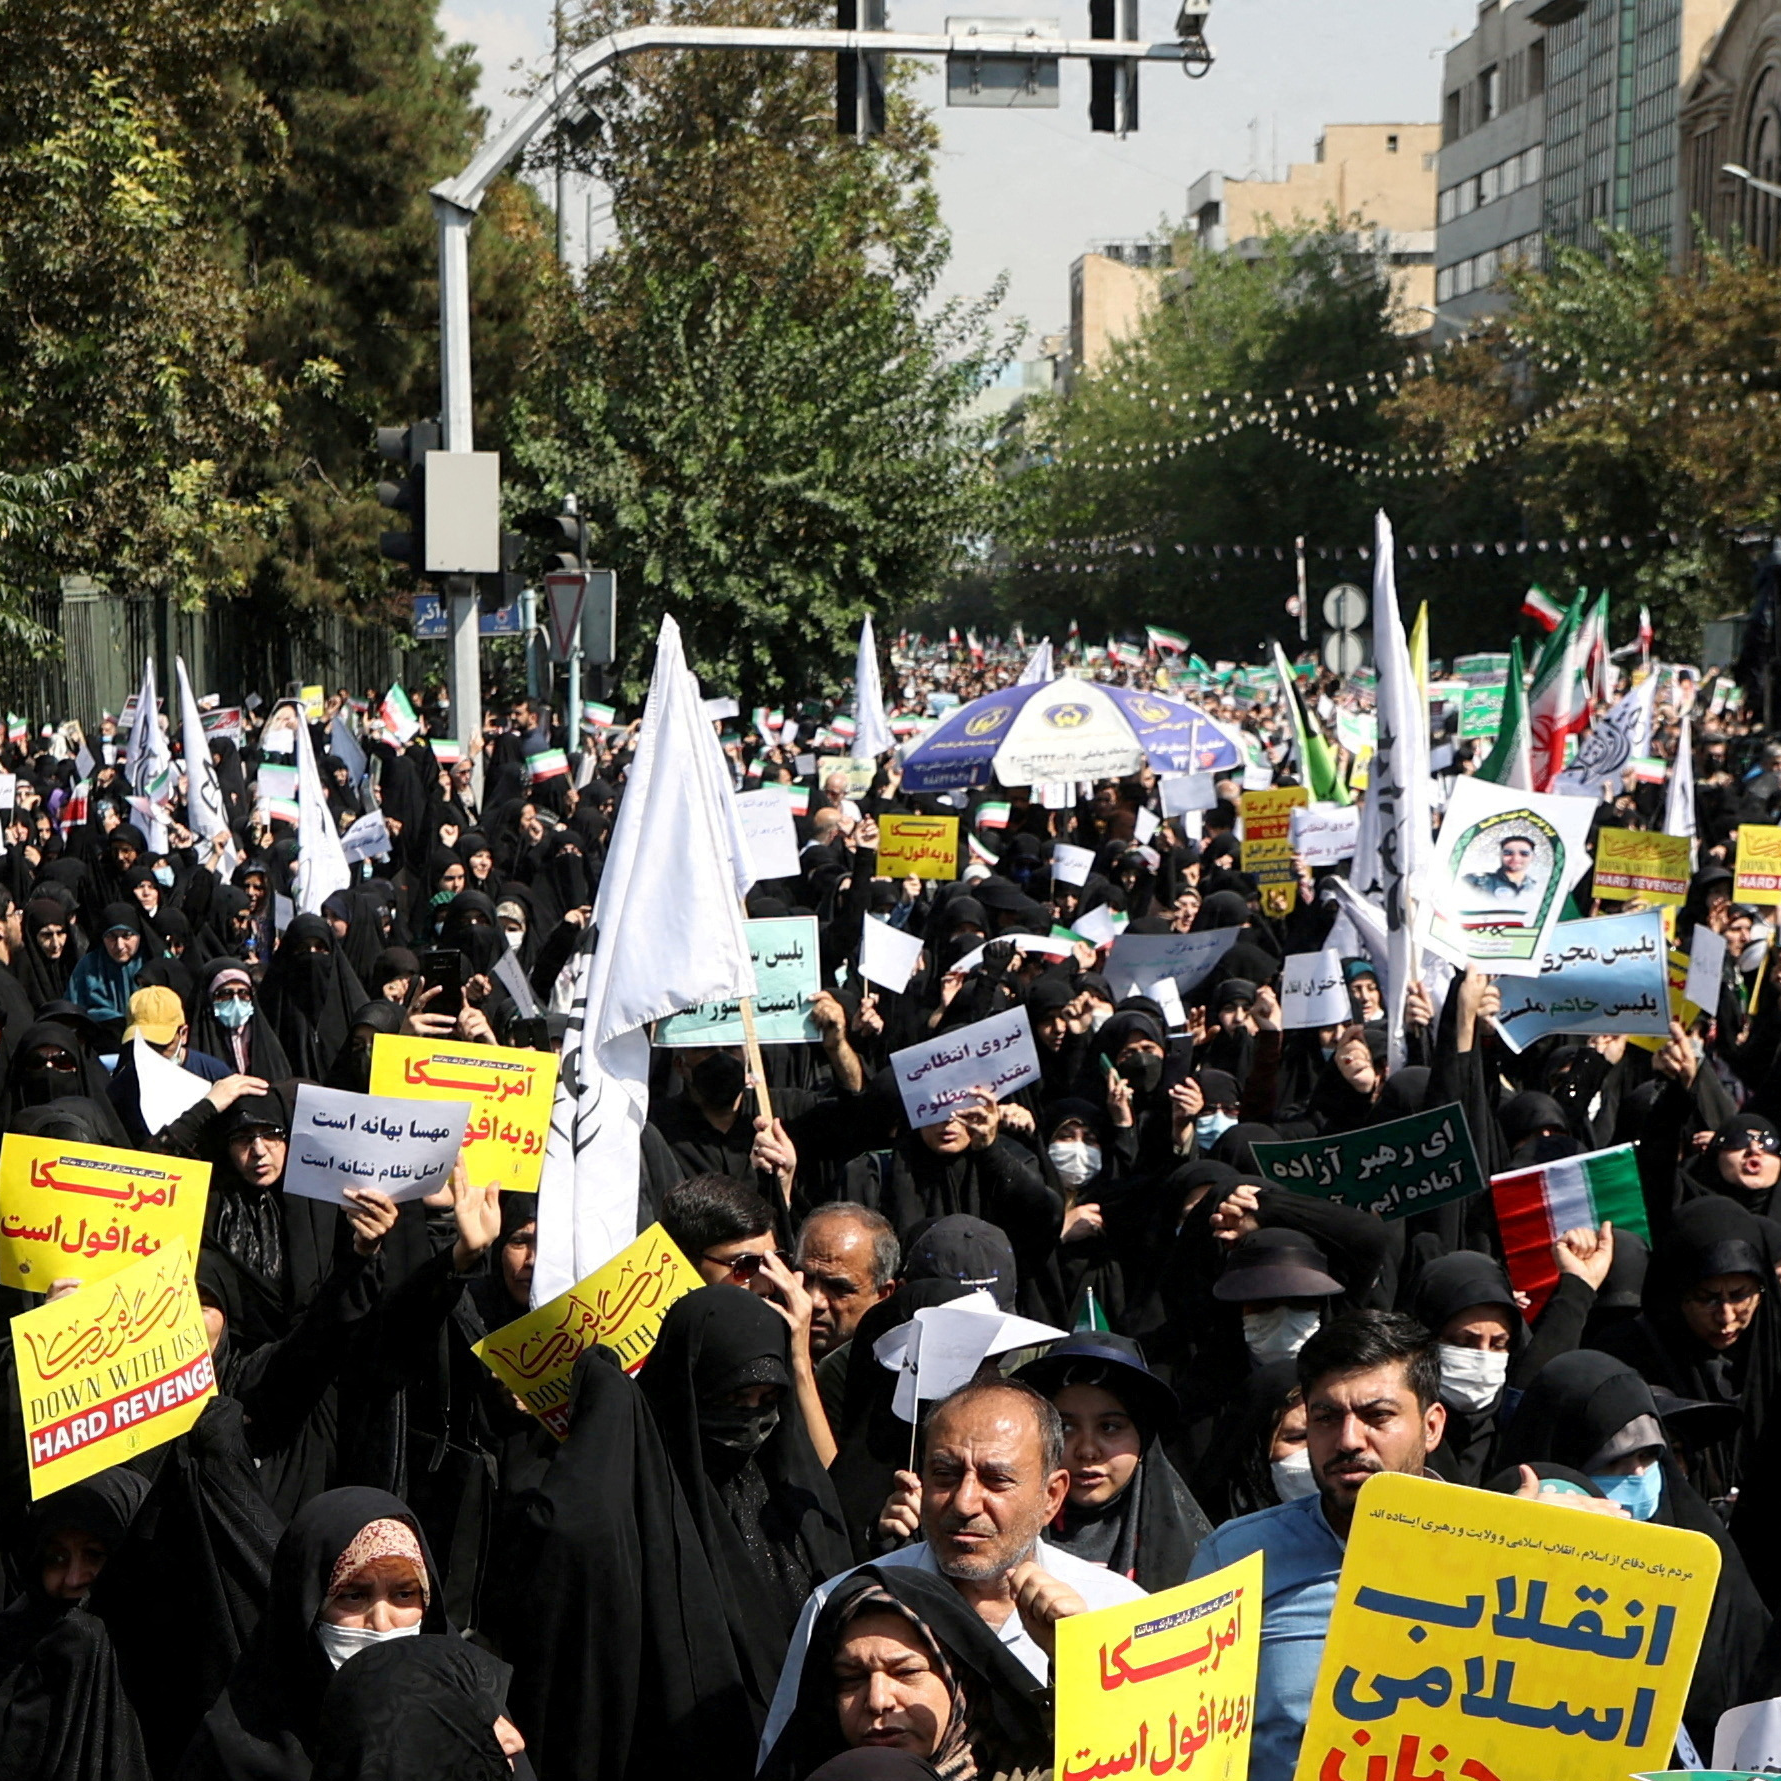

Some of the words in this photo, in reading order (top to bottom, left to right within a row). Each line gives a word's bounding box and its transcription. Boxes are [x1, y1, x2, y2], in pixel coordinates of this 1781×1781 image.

[1594, 871, 1631, 888] HARD
[1631, 874, 1687, 895] REVENGE
[1736, 873, 1778, 890] HARD
[1600, 934, 1657, 966] پلیس
[1602, 991, 1659, 1018] پلیس
[975, 1023, 1023, 1058] نیروی
[905, 1043, 970, 1083] انتظامی
[404, 1056, 537, 1103] آمریکا
[989, 1062, 1033, 1094] مقتدر
[311, 1111, 356, 1133] است
[360, 1115, 404, 1144] بهانه
[408, 1120, 450, 1143] مهسا
[1419, 1118, 1455, 1160] ای
[300, 1151, 335, 1171] است
[337, 1157, 375, 1178] نشانه
[378, 1164, 413, 1184] نظام
[414, 1160, 445, 1182] اصل
[1271, 1144, 1342, 1186] آزاده
[1356, 1143, 1418, 1181] رهبر
[30, 1157, 183, 1213] آمریکا
[1405, 1160, 1463, 1200] آماده
[0, 1213, 63, 1245] است
[60, 1216, 131, 1259] افول
[30, 1373, 102, 1426] DOWN
[107, 1344, 167, 1392] WITH
[171, 1323, 205, 1371] USA
[32, 1410, 109, 1464] HARD
[113, 1357, 214, 1430] REVENGE
[1368, 1507, 1386, 1521] اند
[1385, 1512, 1421, 1529] ایستاده
[1420, 1517, 1457, 1536] رهبری
[1457, 1525, 1465, 1539] و
[1466, 1525, 1498, 1545] ولایت
[1497, 1535, 1506, 1547] و
[1505, 1533, 1544, 1551] اسلامی
[1543, 1540, 1577, 1558] انقلاب
[1580, 1548, 1609, 1564] اسلام
[1607, 1553, 1620, 1568] از
[1619, 1553, 1647, 1572] دفاع
[1646, 1560, 1667, 1580] پای
[1666, 1564, 1696, 1583] مردم
[1354, 1574, 1677, 1666] انقلاب
[1099, 1586, 1245, 1692] آمریکا
[1332, 1655, 1657, 1748] اسلامی
[1217, 1695, 1235, 1745] به
[1234, 1692, 1251, 1740] رو
[1149, 1691, 1217, 1777] افول
